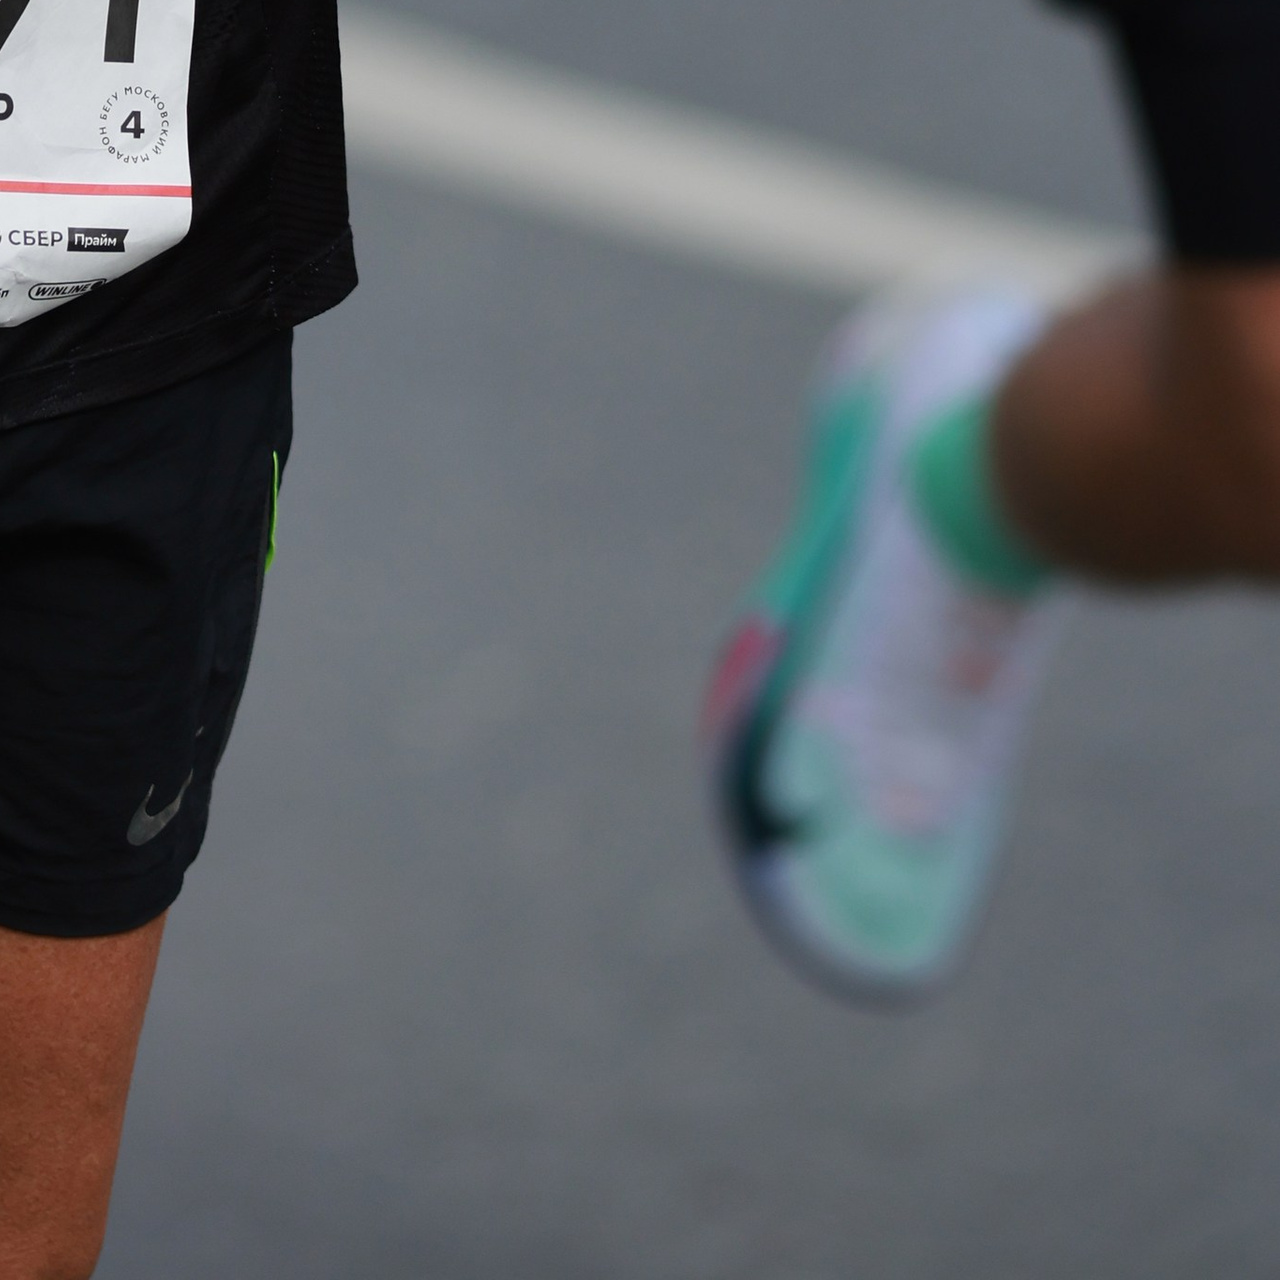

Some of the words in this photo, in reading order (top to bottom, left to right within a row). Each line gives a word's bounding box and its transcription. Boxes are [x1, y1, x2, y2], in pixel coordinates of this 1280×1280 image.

[99, 91, 118, 120] БЕГУ
[120, 110, 145, 139] 4
[124, 86, 169, 155] МОСКОВСКИЙ
[99, 126, 150, 164] МАРАФОН
[8, 230, 63, 246] СБЕР
[74, 233, 117, 248] Прайм
[35, 283, 91, 297] WINLINE
